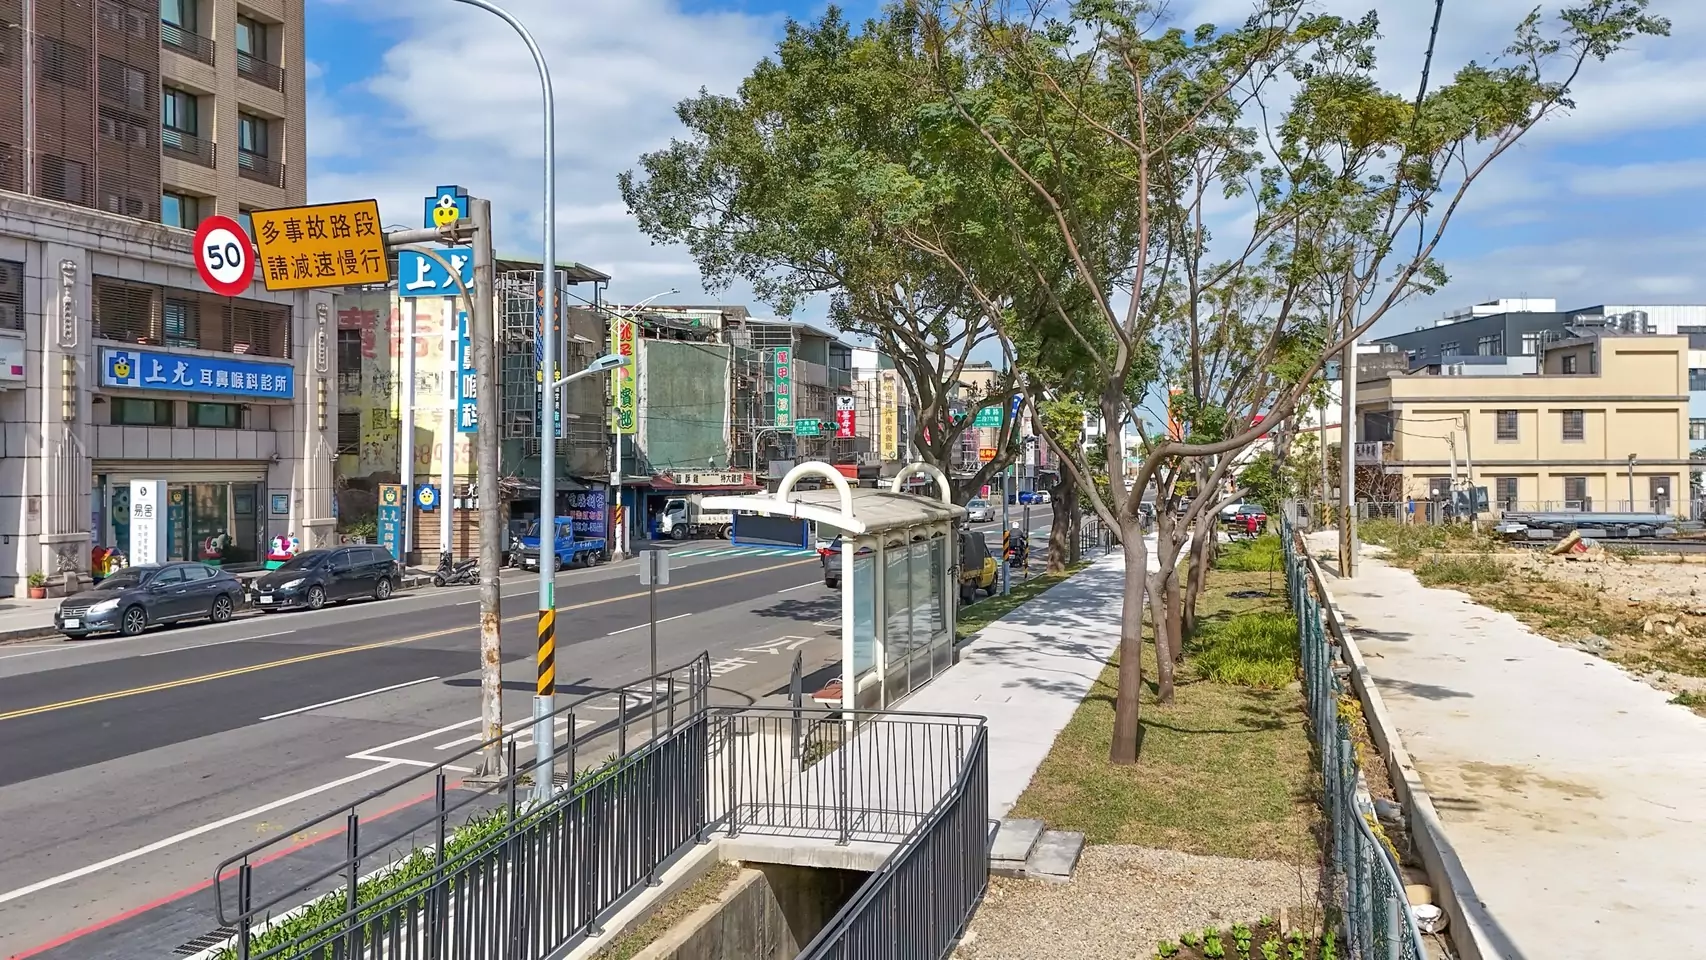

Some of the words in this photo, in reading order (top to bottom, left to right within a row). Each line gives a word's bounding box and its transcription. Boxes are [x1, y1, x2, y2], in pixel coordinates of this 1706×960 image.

[262, 211, 376, 245] 多事故路段
[207, 242, 241, 270] 50
[267, 249, 381, 281] 請減速慢行
[145, 359, 194, 387] 上尤
[200, 368, 287, 393] 耳鼻喉科診所
